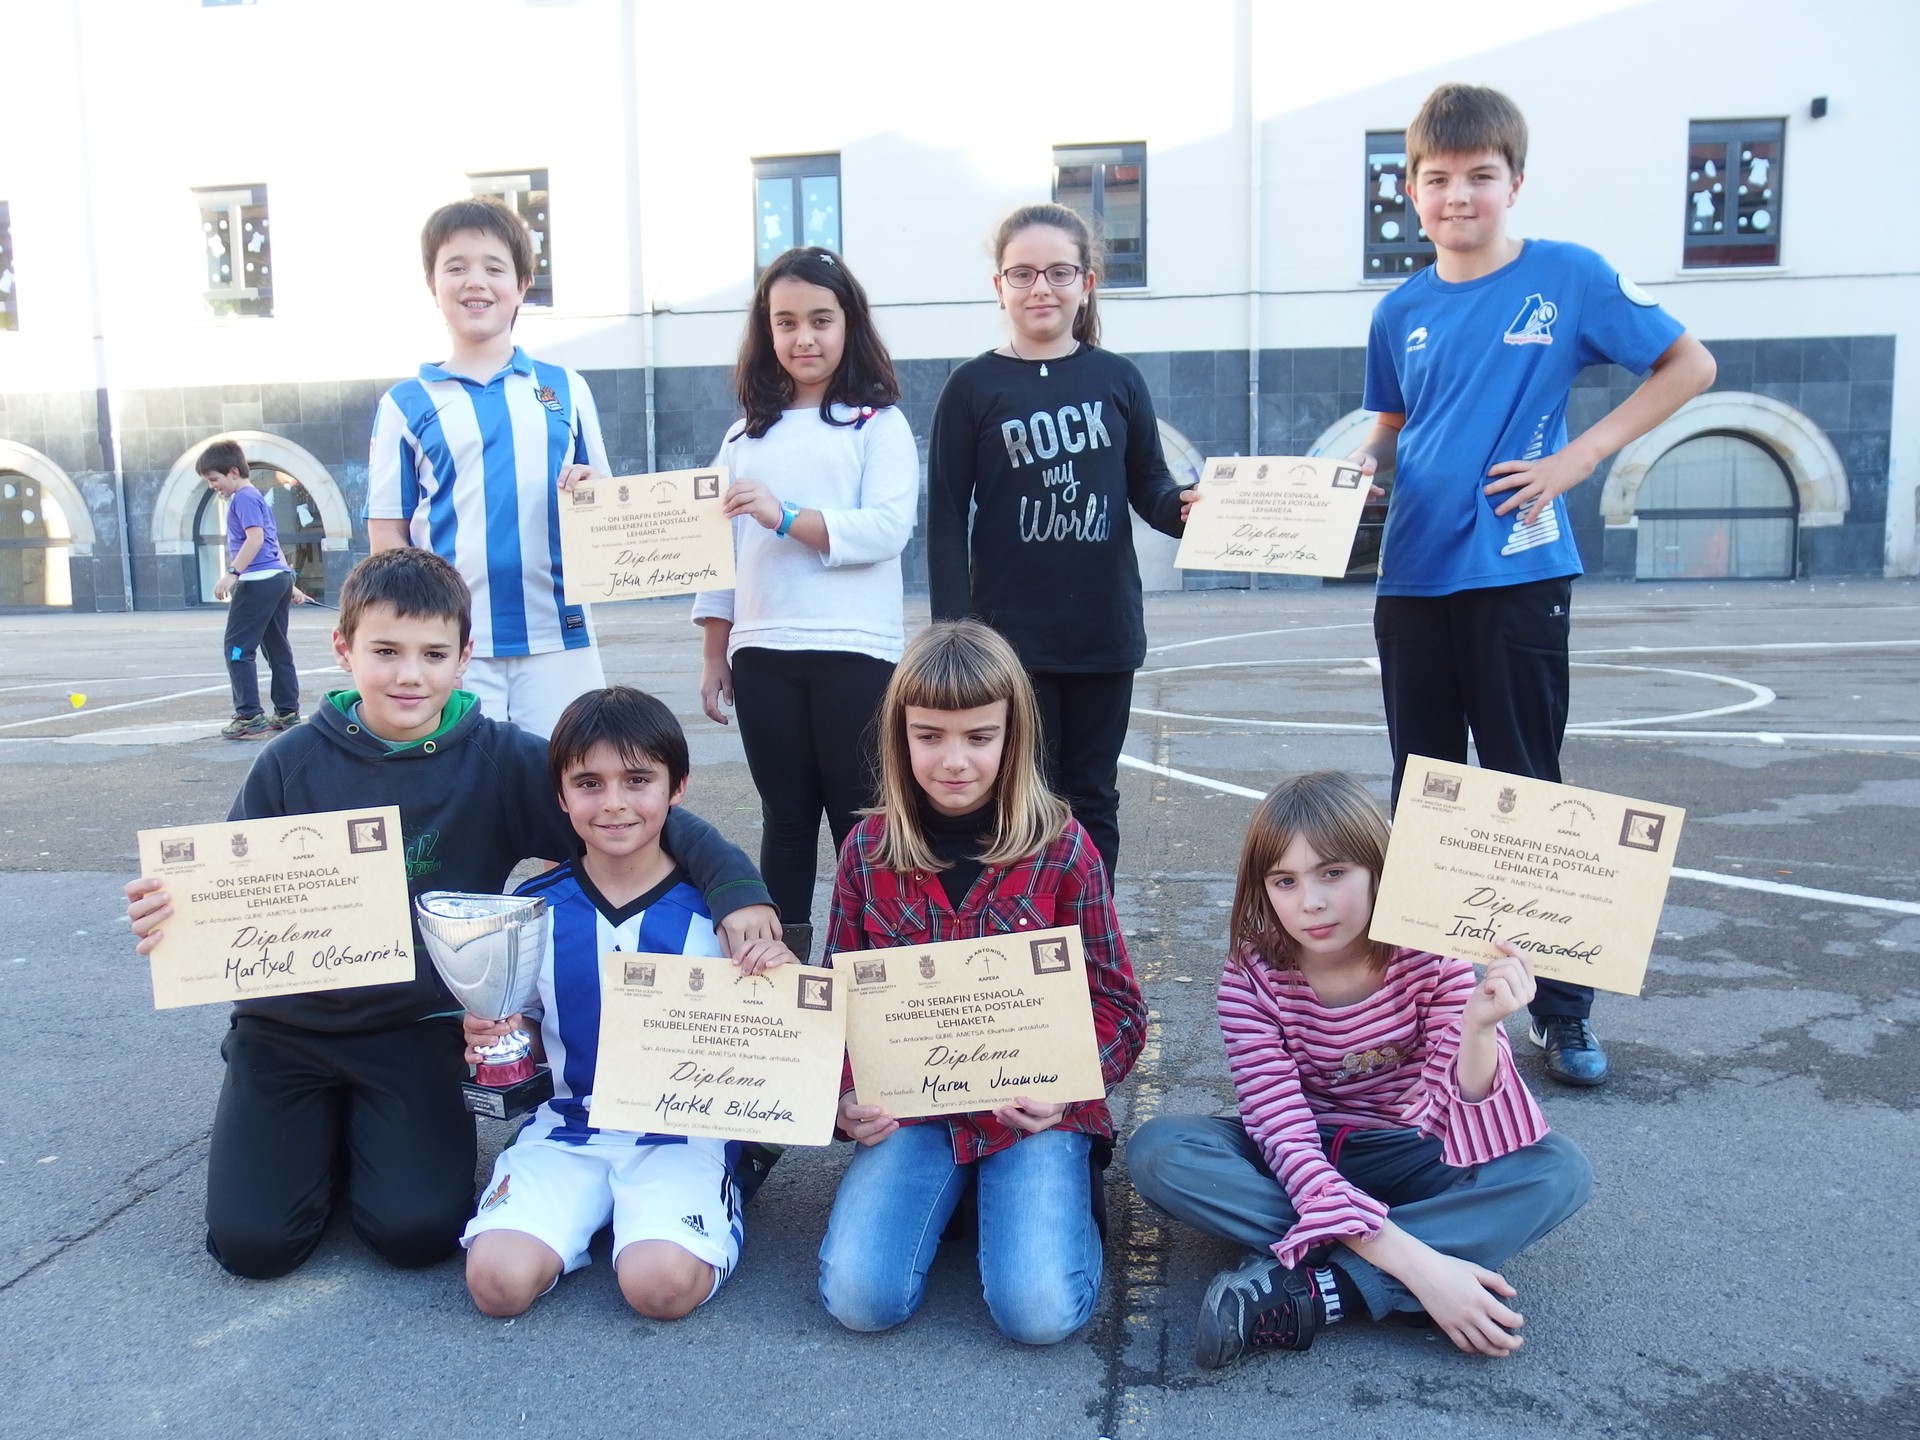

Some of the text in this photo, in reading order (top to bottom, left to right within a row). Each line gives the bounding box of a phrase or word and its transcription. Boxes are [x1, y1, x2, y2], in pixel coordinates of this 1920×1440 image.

[1001, 401, 1111, 468] ROCK
[1042, 460, 1081, 503] my
[622, 513, 651, 522] SERAFIN
[653, 509, 686, 519] ESNAOLA
[1019, 493, 1111, 542] World
[591, 522, 643, 532] ESKUBELENEN
[627, 528, 666, 537] LEHIAKETA
[1232, 524, 1299, 541] Diploma
[615, 548, 681, 567] Diploma
[1440, 836, 1524, 860] ESKUBELENEN
[1527, 853, 1549, 865] ETA
[1471, 829, 1490, 840] ON
[1493, 833, 1542, 850] SERAFIN
[1545, 843, 1600, 862] ESNAOLA
[217, 877, 235, 888] ON
[238, 872, 284, 885] SERAFIN
[287, 867, 339, 881] ESNAOLA
[1494, 860, 1559, 881] LEHIAKETA
[1487, 872, 1507, 883] GURE
[1510, 878, 1542, 891] AMETSA
[191, 886, 272, 903] ESKUBELENEN
[274, 883, 295, 893] ETA
[247, 894, 308, 908] LEHIAKETA
[244, 911, 264, 920] GURE
[266, 908, 297, 918] AMETSA
[1463, 887, 1573, 925] Diploma
[231, 923, 332, 951] Diploma
[1445, 914, 1502, 943] Irati
[225, 947, 296, 988] Martxel
[908, 998, 925, 1008] ON
[927, 994, 971, 1007] SERAFIN
[974, 987, 1025, 1002] ESNAOLA
[669, 1010, 685, 1018] ON
[688, 1011, 731, 1022] SERAFIN
[734, 1015, 783, 1026] ESNAOLA
[885, 1007, 960, 1022] ESKUBELENEN
[962, 1004, 983, 1015] ETA
[937, 1015, 995, 1029] LEHIAKETA
[643, 1019, 717, 1033] ESKUBELENEN
[720, 1025, 739, 1034] ETA
[903, 1035, 933, 1043] Antonioko
[956, 1030, 984, 1038] AMETSA
[1018, 1023, 1049, 1031] antolatuta
[692, 1035, 750, 1047] LEHIAKETA
[924, 1043, 1020, 1070] Diploma
[669, 1061, 766, 1089] Diploma
[921, 1075, 971, 1102] Maren
[655, 1093, 714, 1121] Markel
